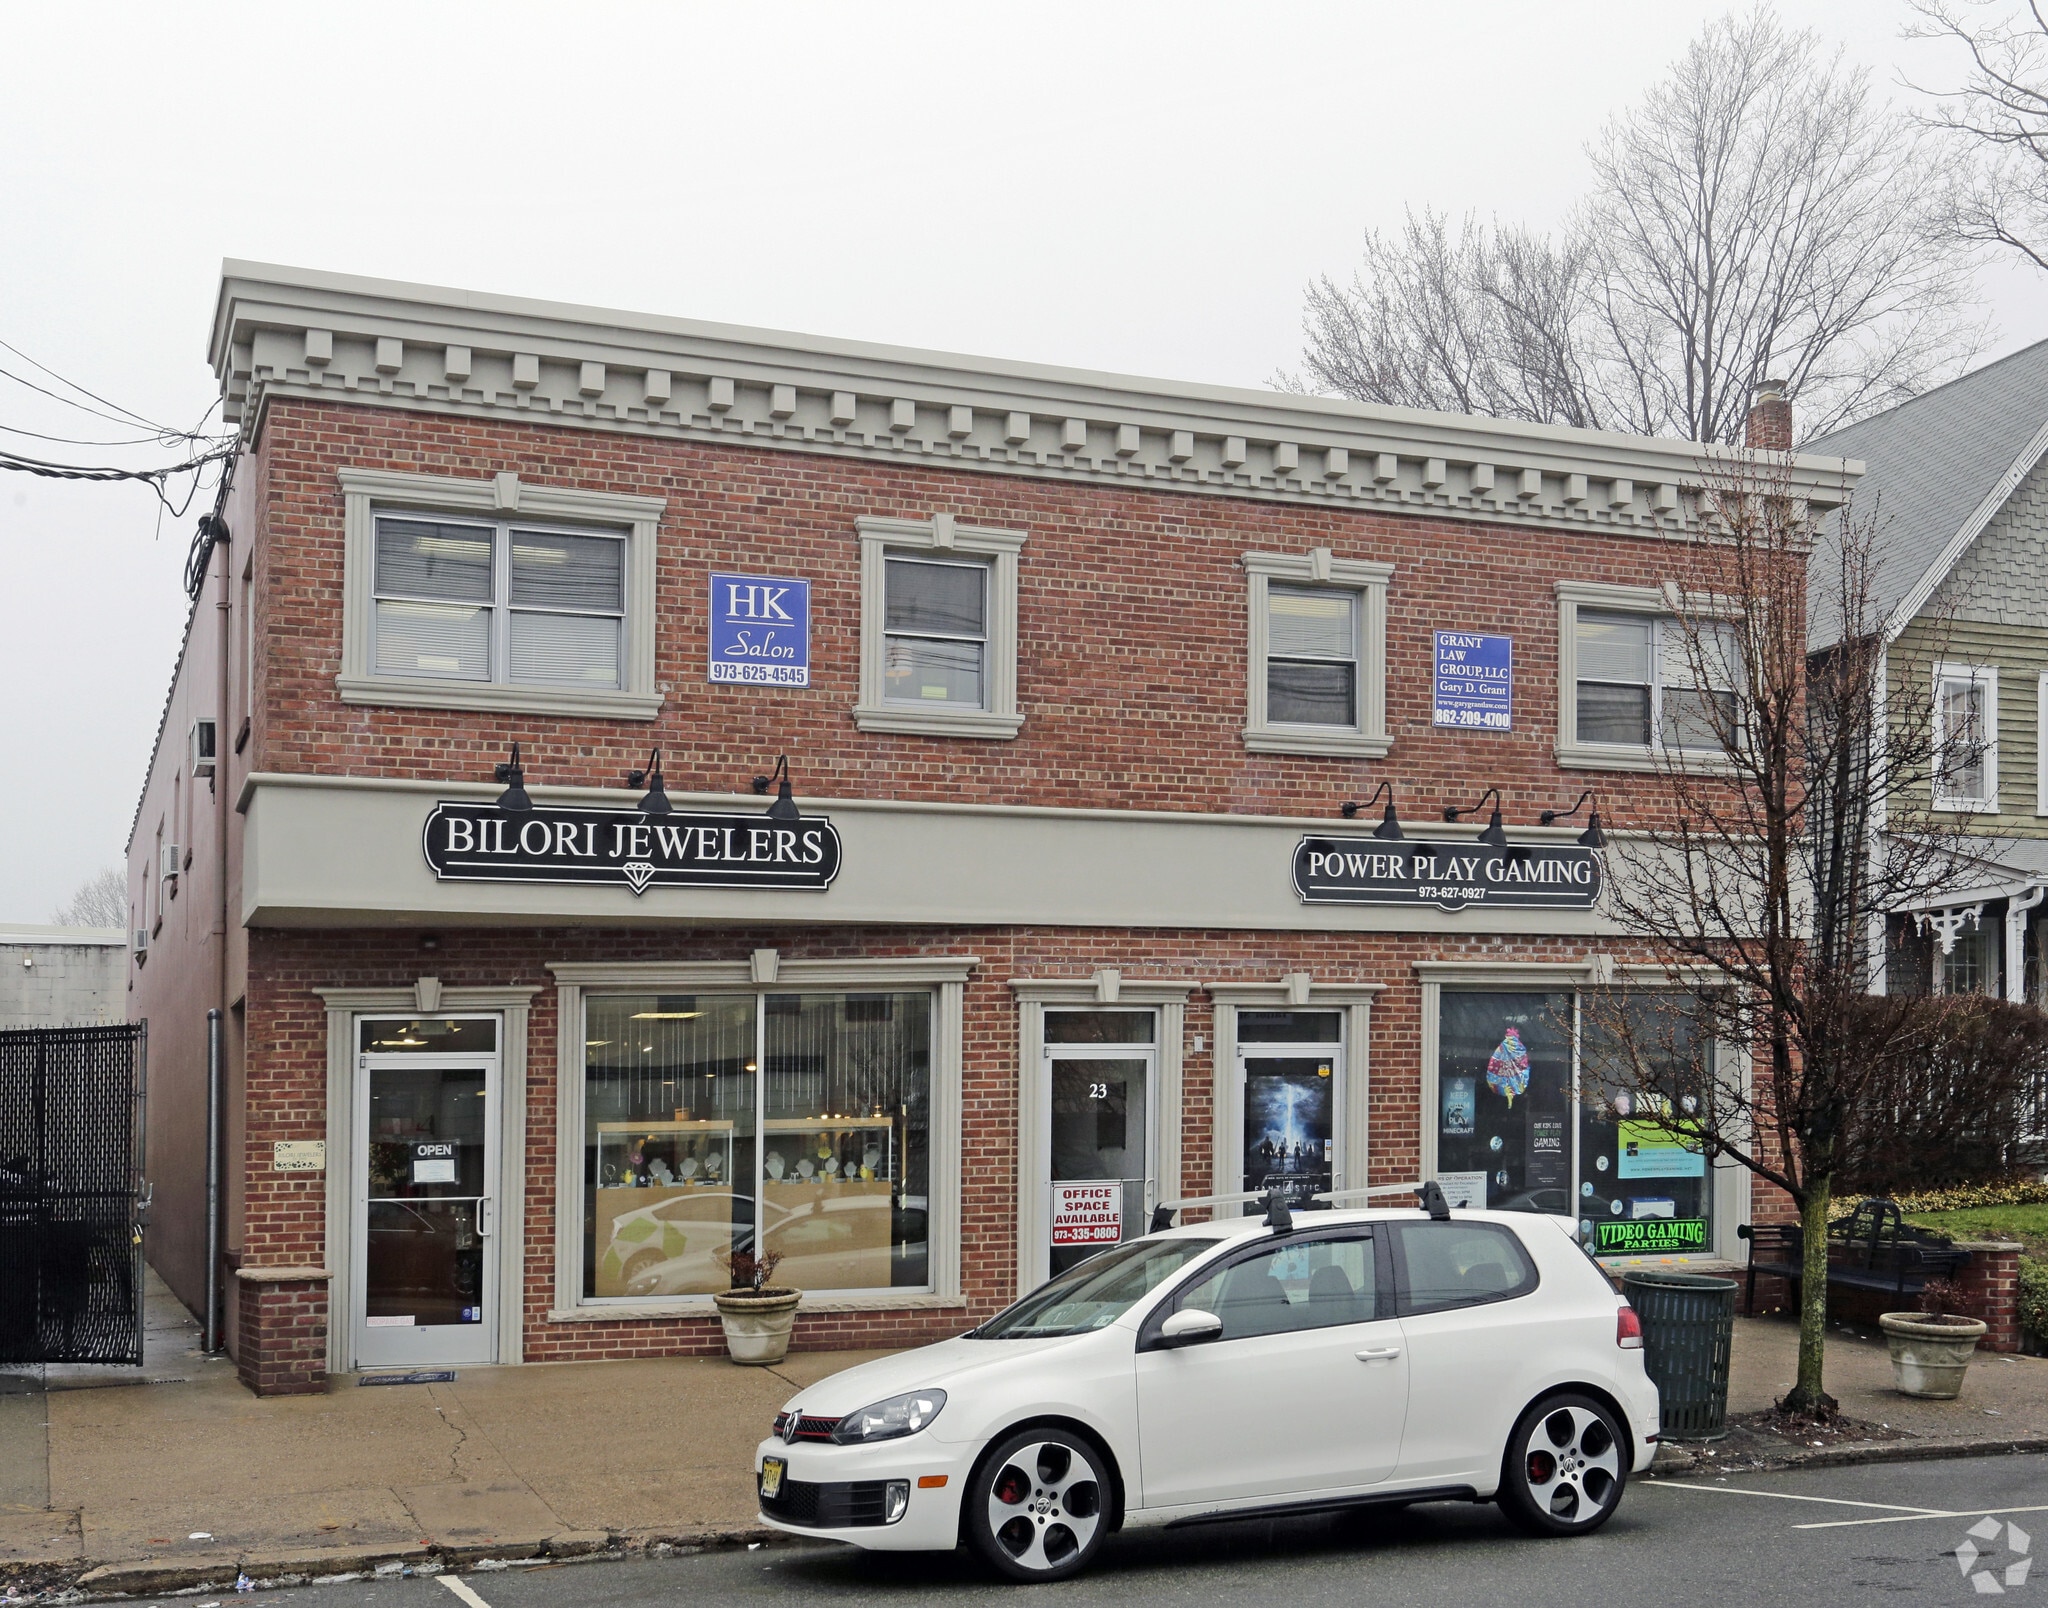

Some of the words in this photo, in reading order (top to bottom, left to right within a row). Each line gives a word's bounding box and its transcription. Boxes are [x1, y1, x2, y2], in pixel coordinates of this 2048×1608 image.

[726, 584, 794, 620] HK
[724, 631, 795, 659] Salon
[1440, 635, 1483, 649] GRANT
[1440, 649, 1467, 661] LAW
[714, 664, 805, 683] 973-625-4545
[1440, 681, 1463, 695] Gary
[1465, 683, 1477, 693] D.
[1479, 684, 1506, 695] Grant
[1438, 700, 1508, 710] www.garygrantlaw.com
[1436, 709, 1509, 727] 862-209-4700
[444, 817, 598, 857] BILORI
[608, 824, 824, 864] JEWELERS
[1308, 852, 1406, 879] POWER
[1412, 856, 1481, 881] PLAY
[1486, 858, 1591, 884] GAMING
[1419, 886, 1486, 899] 973-627-0927
[1089, 1083, 1107, 1099] 23
[1449, 1116, 1468, 1125] PLAY
[417, 1144, 452, 1156] OPEN
[1063, 1189, 1112, 1199] OFFICE
[1065, 1201, 1110, 1211] SPACE
[1055, 1213, 1119, 1224] AVAILABLE
[1054, 1227, 1118, 1240] 973-335-0806
[1600, 1223, 1644, 1246] VIDEO
[1647, 1223, 1704, 1244] GAMING
[1624, 1239, 1679, 1248] PARTIES
